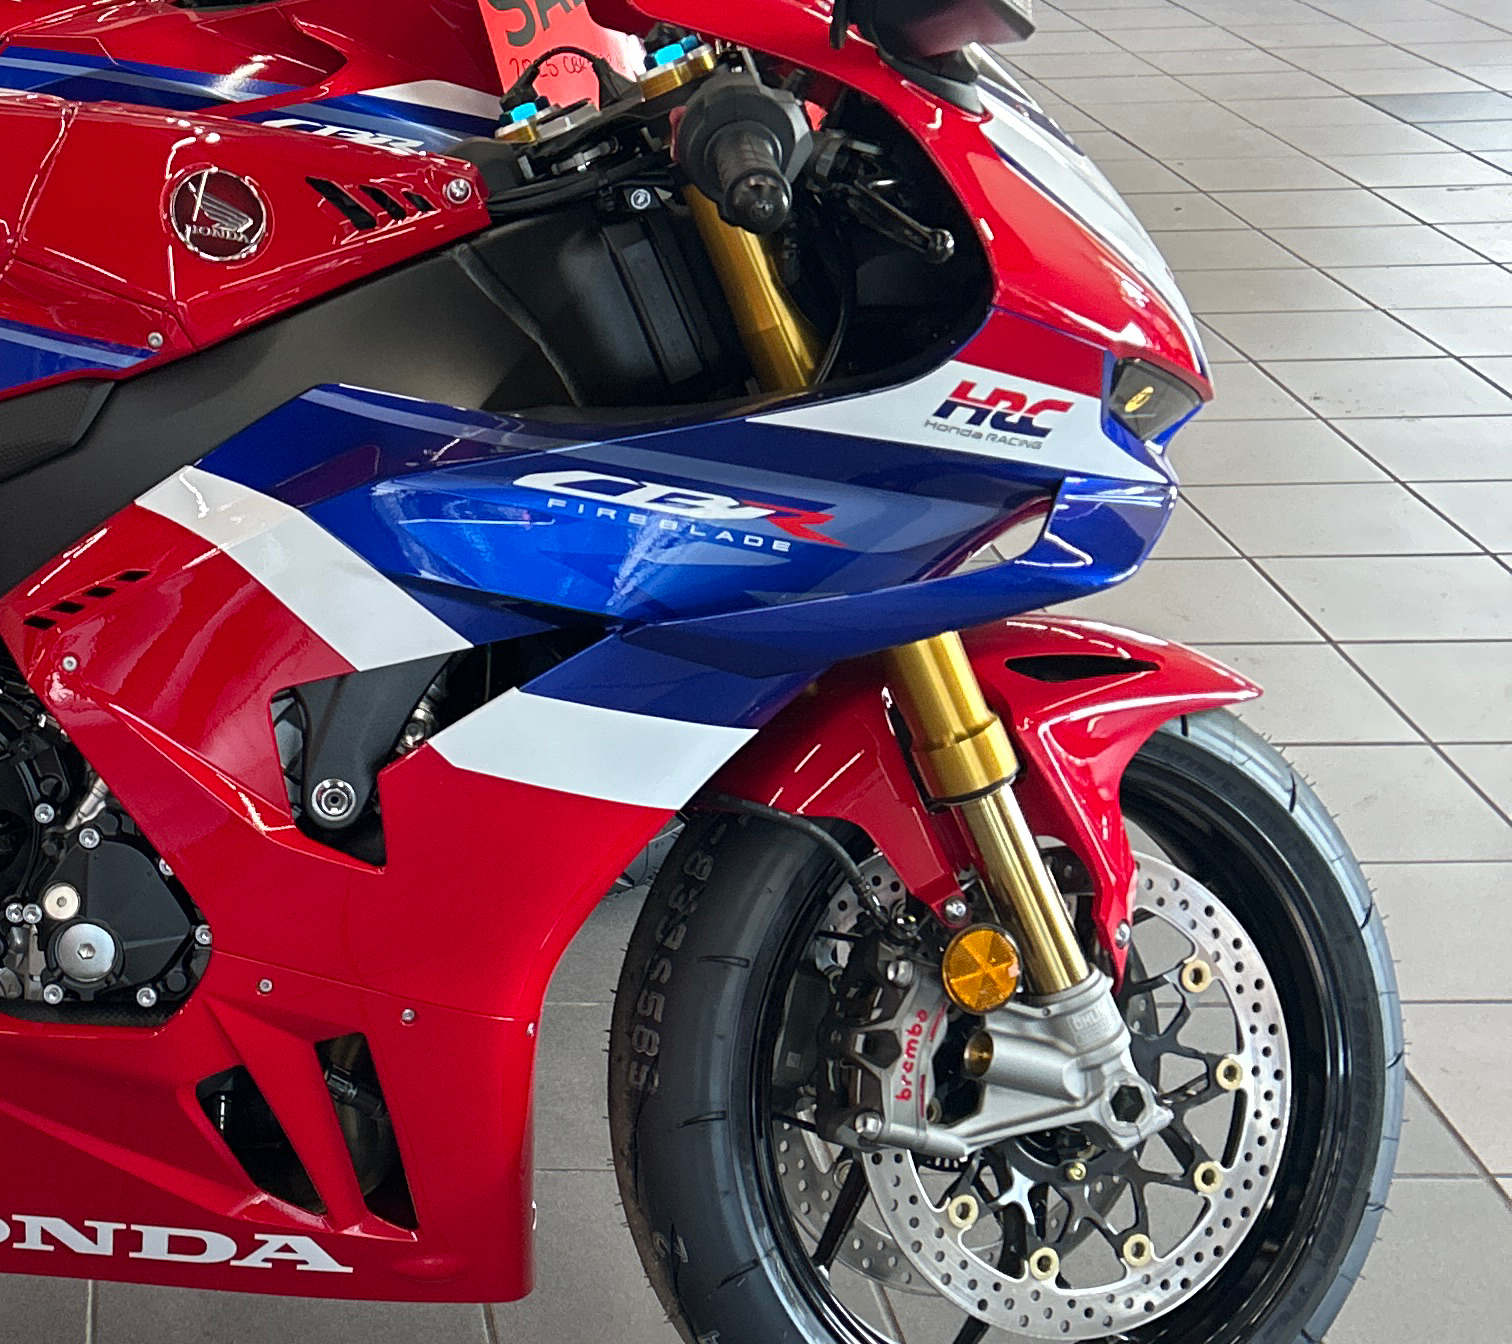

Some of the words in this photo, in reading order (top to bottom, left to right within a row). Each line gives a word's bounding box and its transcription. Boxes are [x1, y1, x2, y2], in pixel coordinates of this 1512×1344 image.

[185, 223, 249, 244] HONDA
[923, 419, 983, 441] Honda
[985, 432, 1044, 451] RACING
[933, 379, 1075, 439] HRC
[546, 497, 792, 553] FIREBLADE
[895, 1009, 930, 1101] brembo
